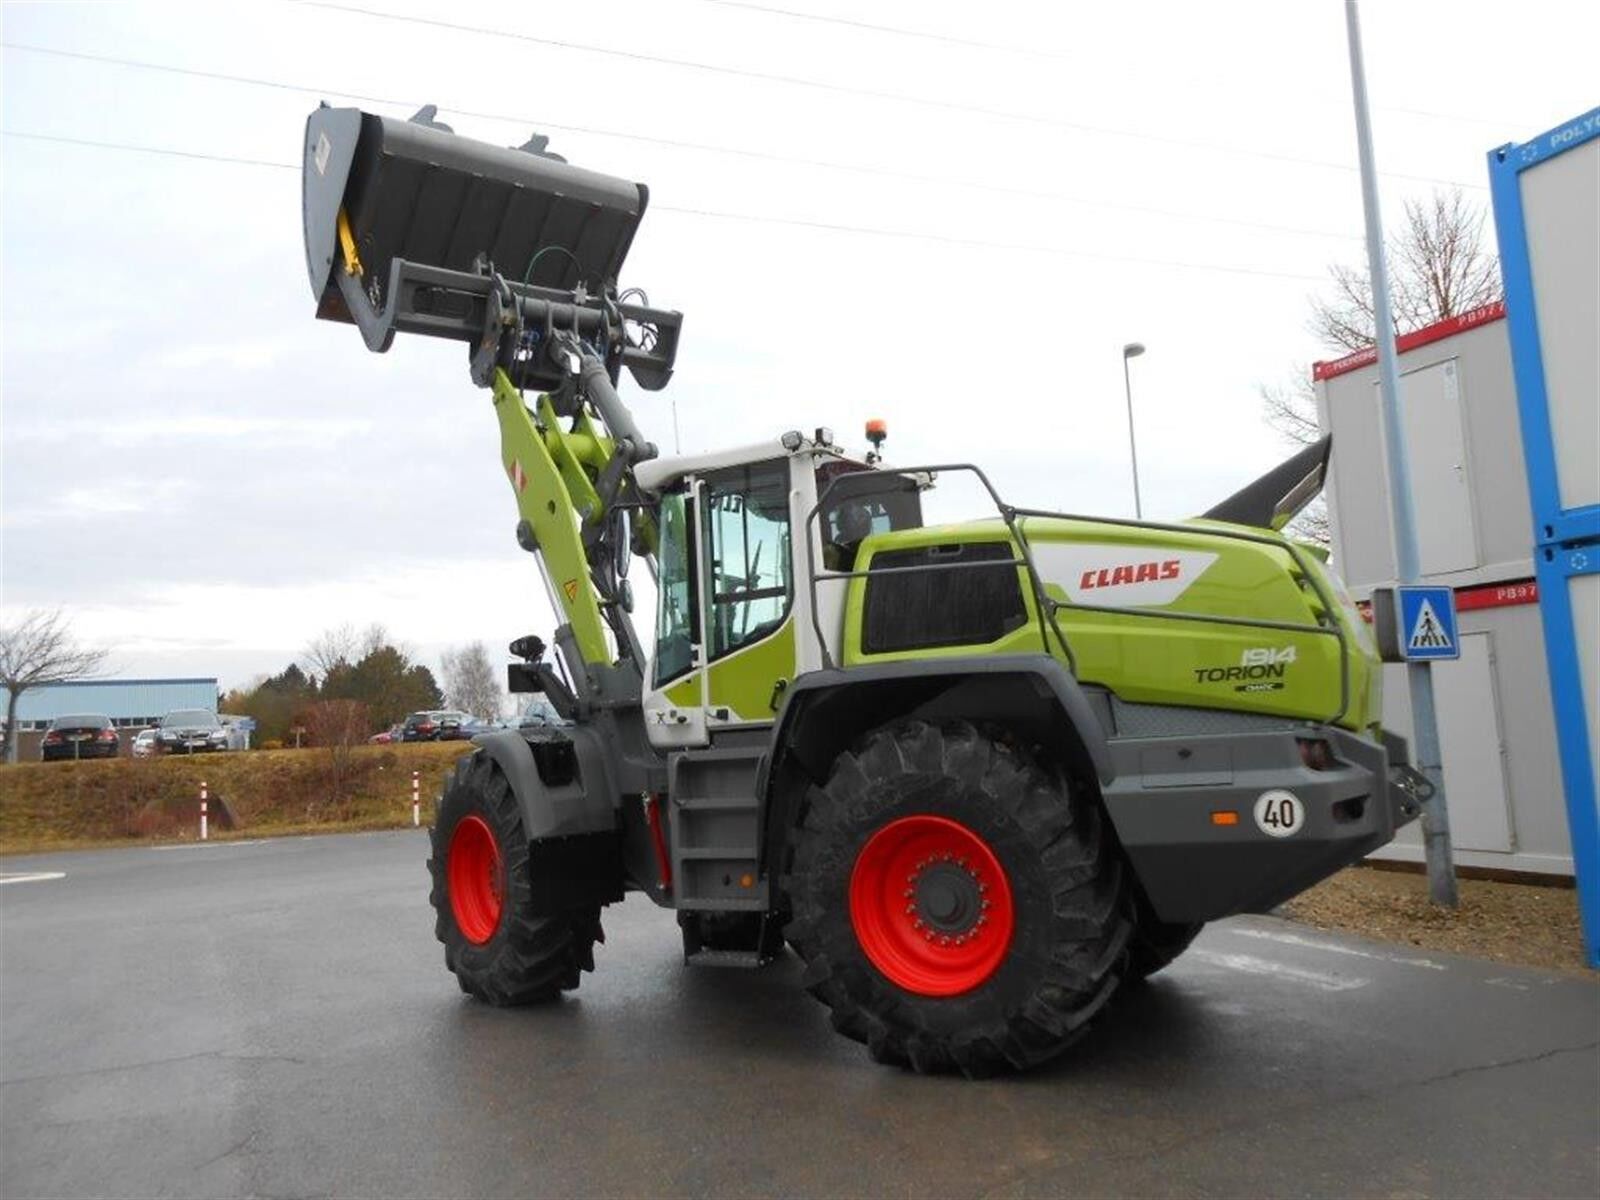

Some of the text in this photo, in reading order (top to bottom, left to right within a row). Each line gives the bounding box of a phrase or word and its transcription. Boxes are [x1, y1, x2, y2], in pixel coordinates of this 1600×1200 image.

[1080, 560, 1180, 590] CLAAS
[1242, 645, 1297, 666] 1914
[1194, 663, 1285, 683] TORION
[1264, 799, 1295, 828] 40
